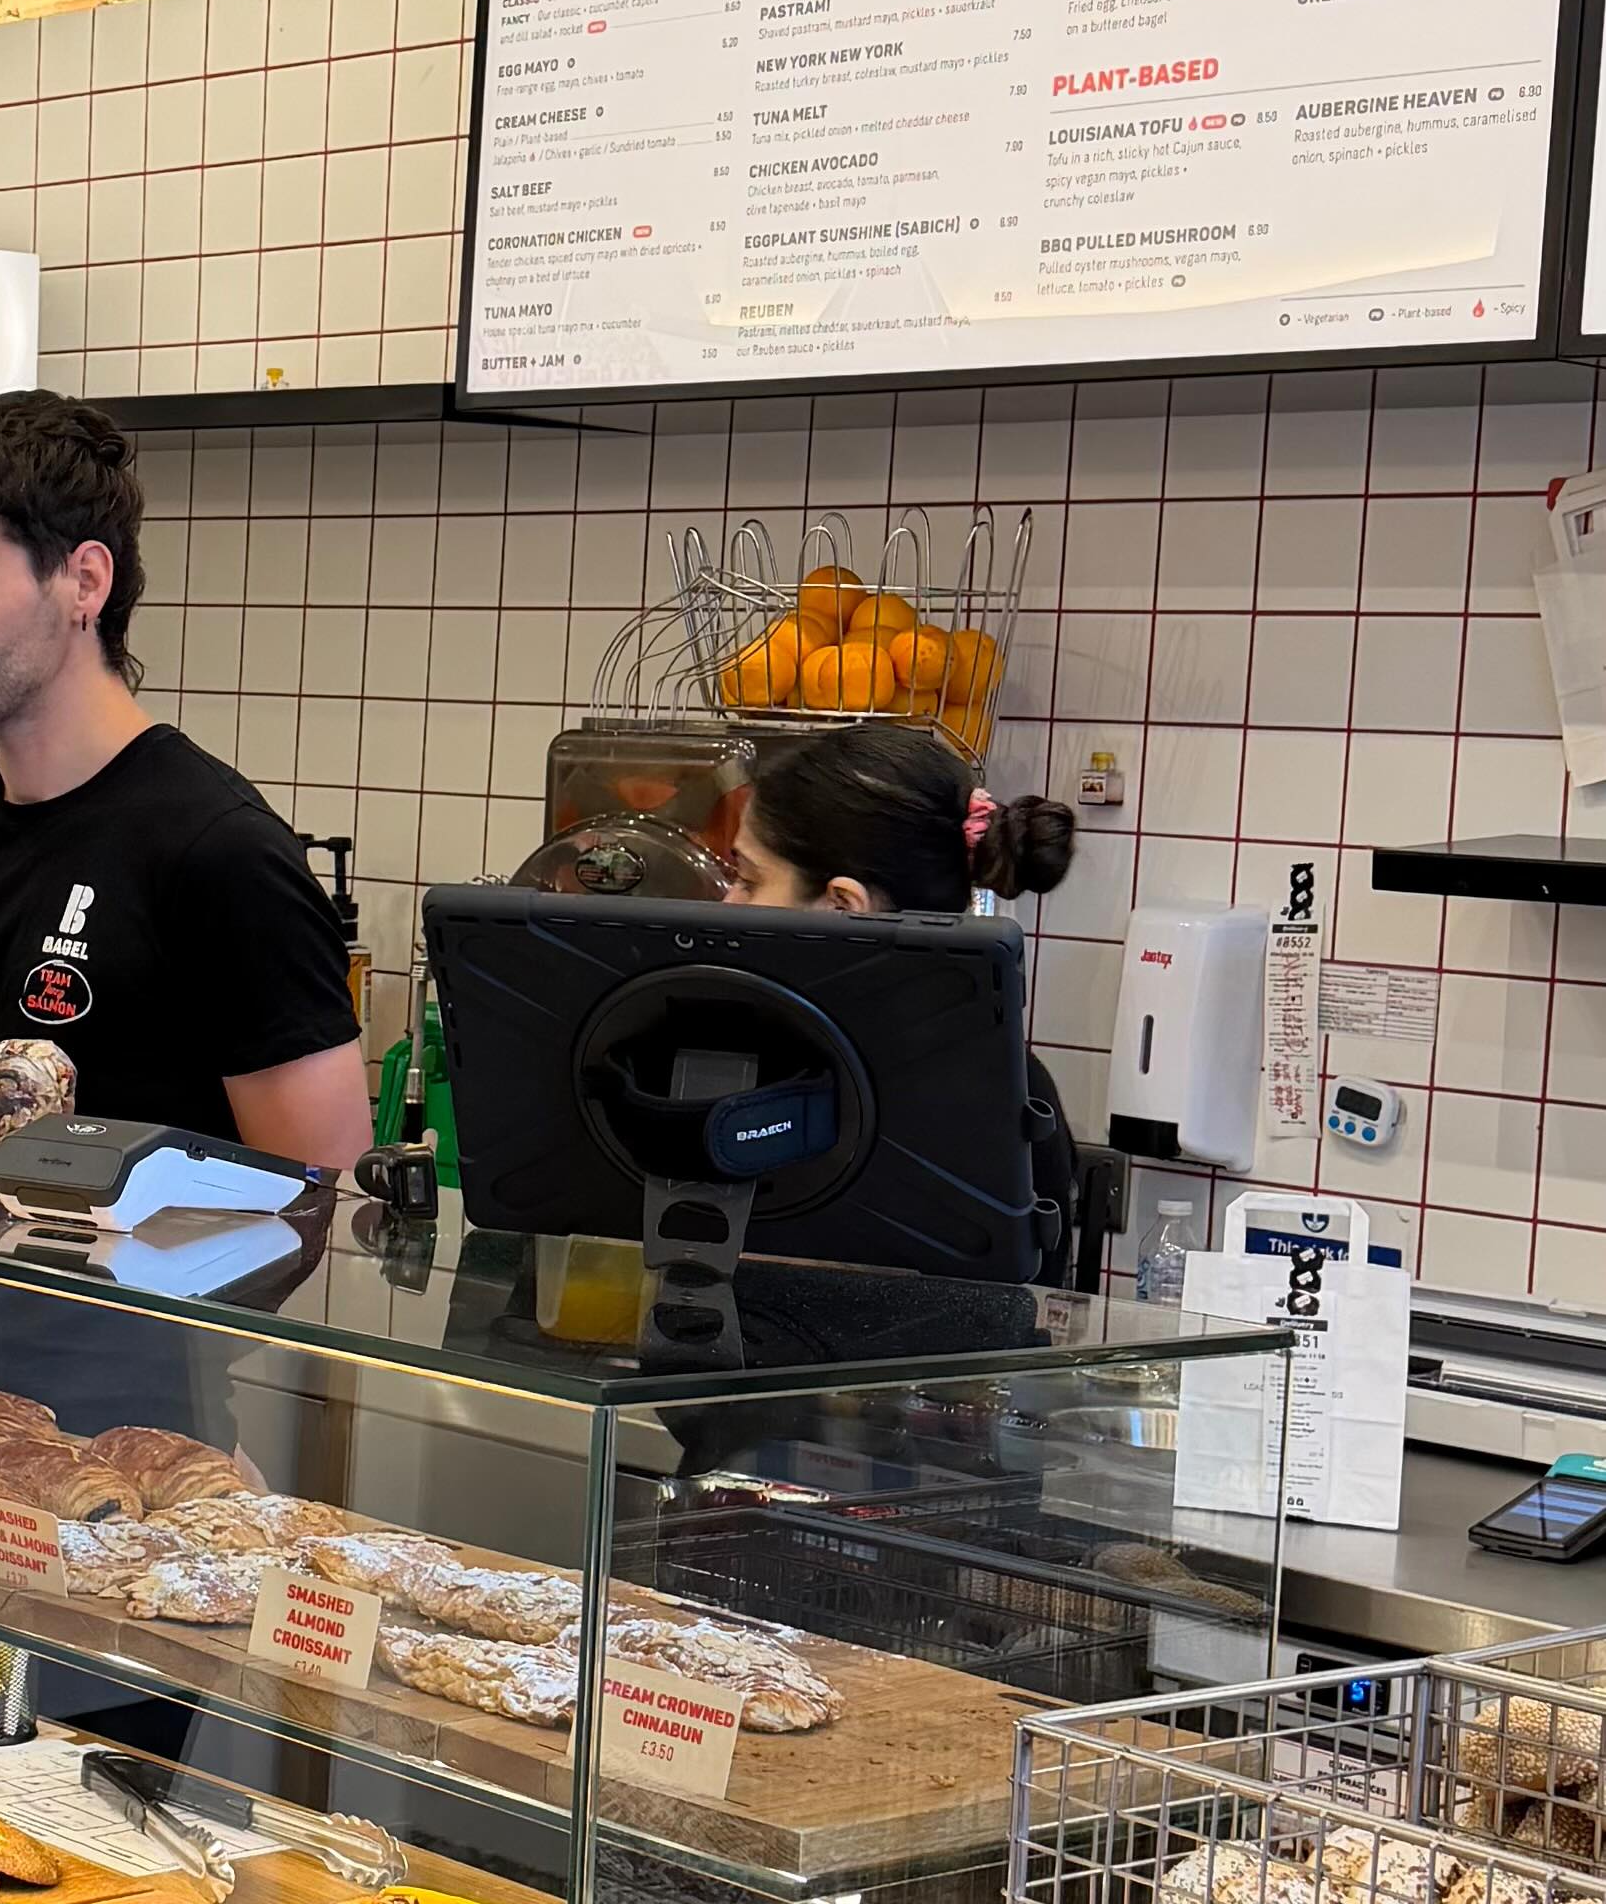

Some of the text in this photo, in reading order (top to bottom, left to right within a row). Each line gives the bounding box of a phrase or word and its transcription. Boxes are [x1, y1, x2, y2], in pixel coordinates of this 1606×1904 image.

[497, 57, 559, 78] EGG MAYO
[755, 40, 903, 74] NEW YORK NEW YORK
[1052, 57, 1219, 97] PLANT-BASED
[752, 103, 828, 126] TUNA MELT
[1294, 86, 1478, 121] AUBERGINE HEAVEN
[494, 106, 587, 130] CREAM CHEESE
[1048, 116, 1183, 145] LOUISIANA TOFU
[748, 151, 878, 178] CHICKEN AVOCADO
[490, 180, 552, 200] SALT BEEF
[487, 226, 622, 251] CORONATION CHICKEN
[743, 215, 960, 249] EGGPLANT SUNSHINE (SABICH)
[1040, 223, 1236, 254] BBQ PULLED MUSHROOM
[483, 302, 553, 320] TUNA MAYO
[739, 302, 794, 319] REUBEN
[481, 355, 527, 370] BUTTER
[538, 353, 565, 367] JAM
[58, 883, 95, 935] B
[41, 935, 89, 960] BAGEL
[40, 968, 72, 988] TEAM
[26, 994, 77, 1016] SALMON
[1268, 1238, 1299, 1256] Thi
[0, 1529, 8, 1543] &
[9, 1532, 59, 1558] ALMOND
[286, 1583, 355, 1616] SMASHED
[286, 1608, 345, 1638] ALMOND
[273, 1628, 353, 1665] CROISSANT
[601, 1678, 736, 1729] CREAM CROWNED
[622, 1708, 704, 1745] CINNABUN
[640, 1740, 675, 1762] £3.50
